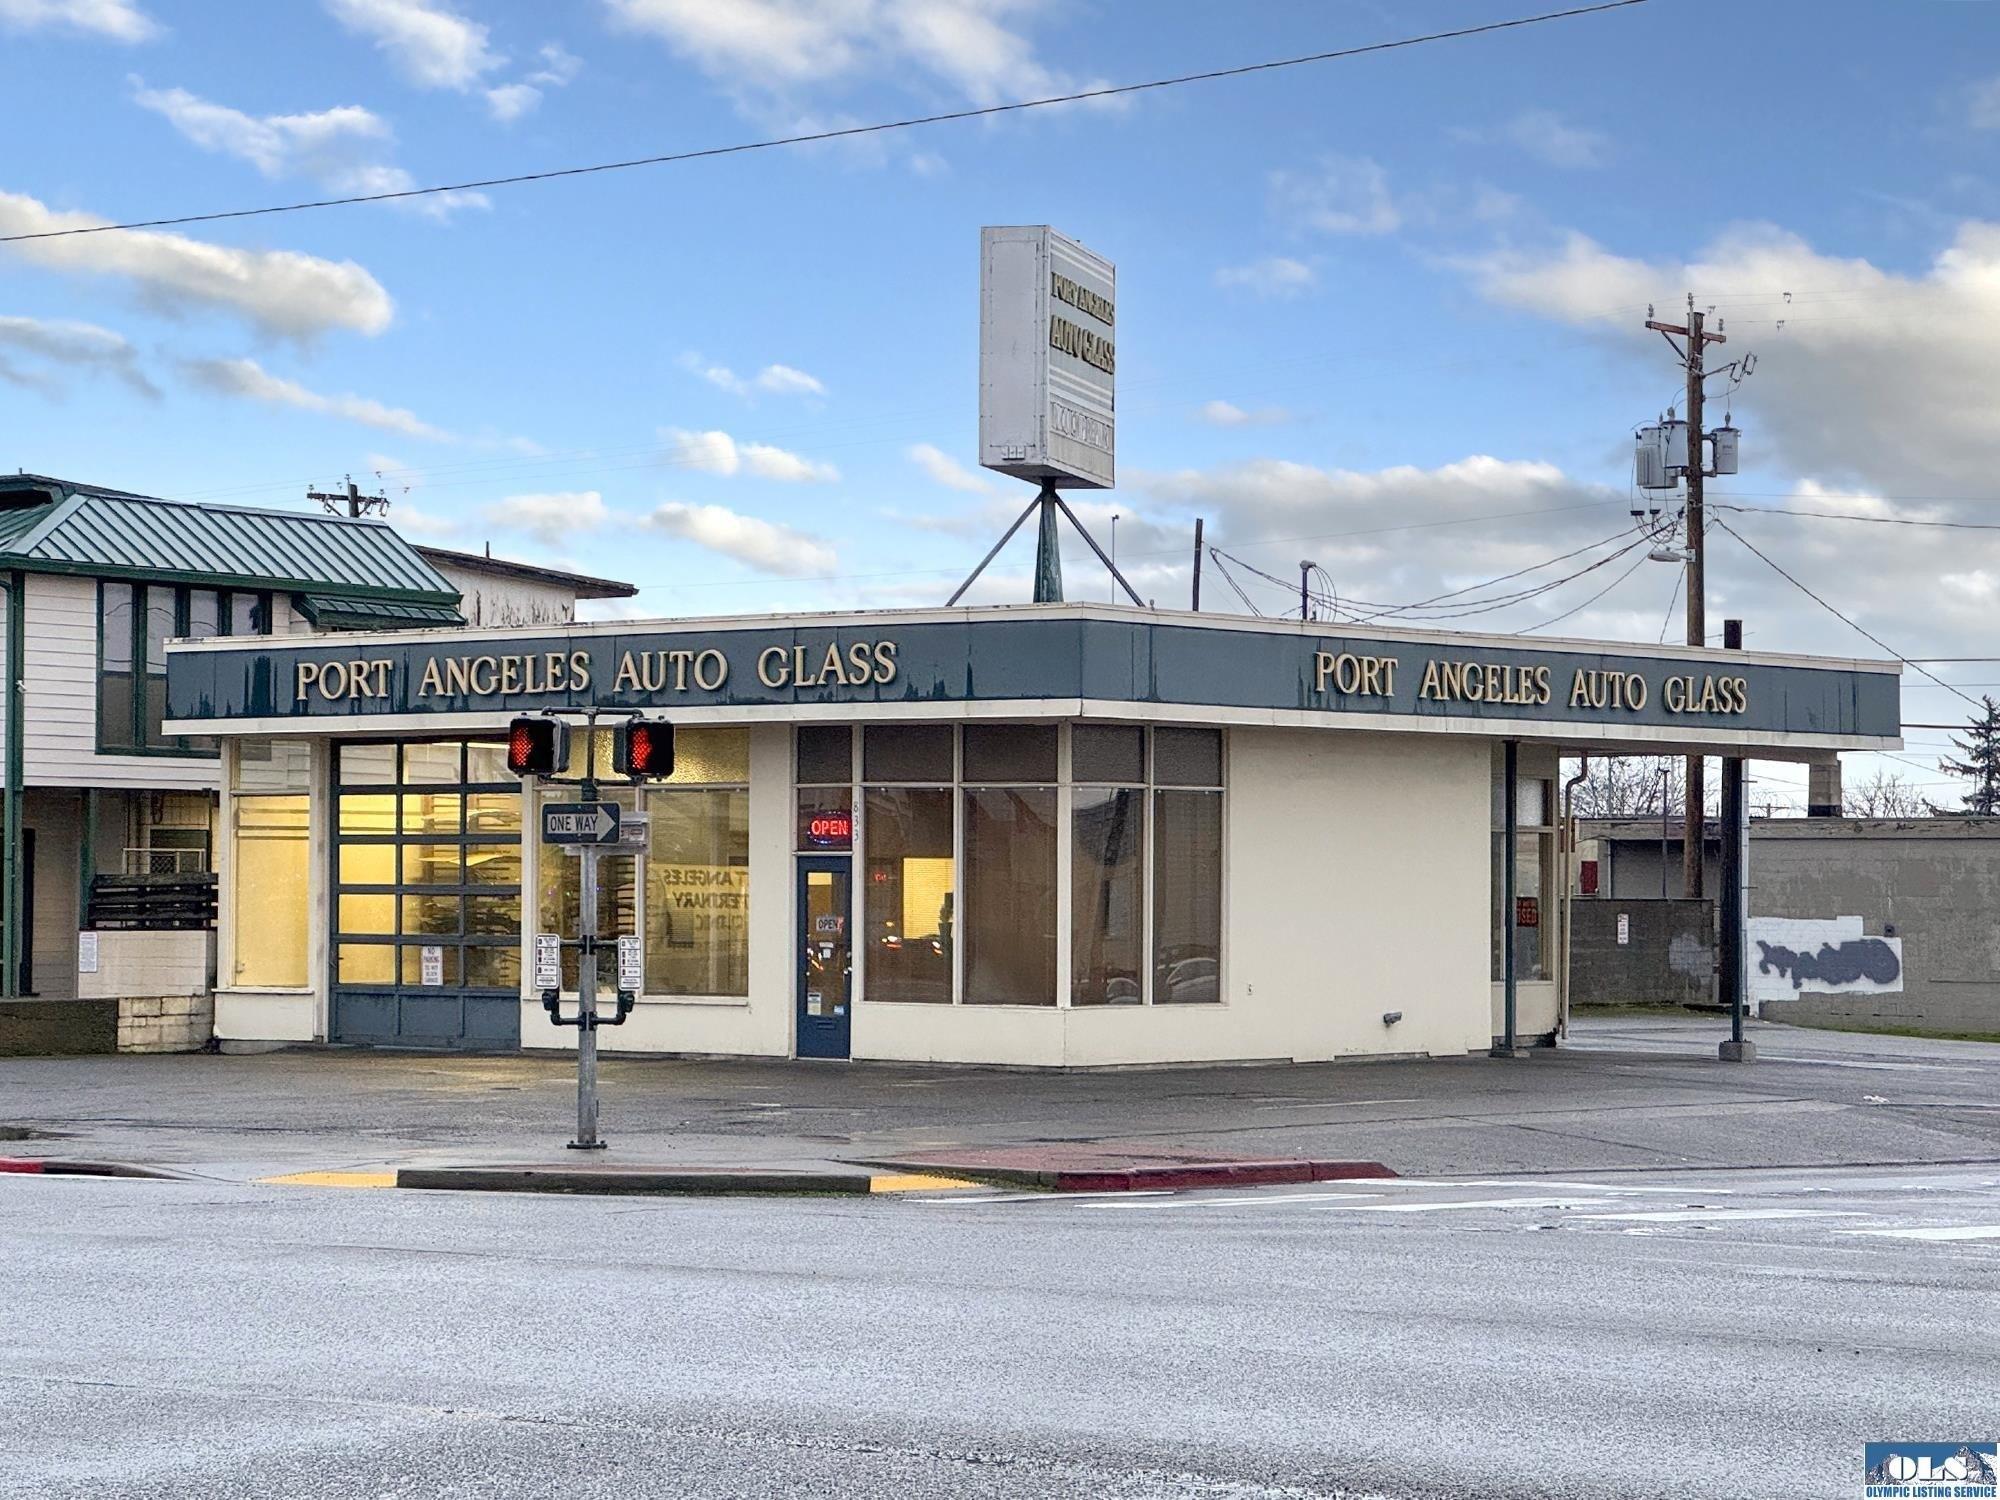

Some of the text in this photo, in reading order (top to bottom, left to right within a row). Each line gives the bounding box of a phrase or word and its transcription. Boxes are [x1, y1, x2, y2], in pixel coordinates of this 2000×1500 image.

[1050, 314, 1081, 358] AUTO
[297, 641, 897, 701] PORT ANGELES AUTO GLASS
[1315, 651, 1748, 714] PORT ANGELES AUTO GLASS
[550, 816, 598, 832] ONE WAY
[811, 820, 849, 836] OPEN
[818, 919, 838, 930] OPEN
